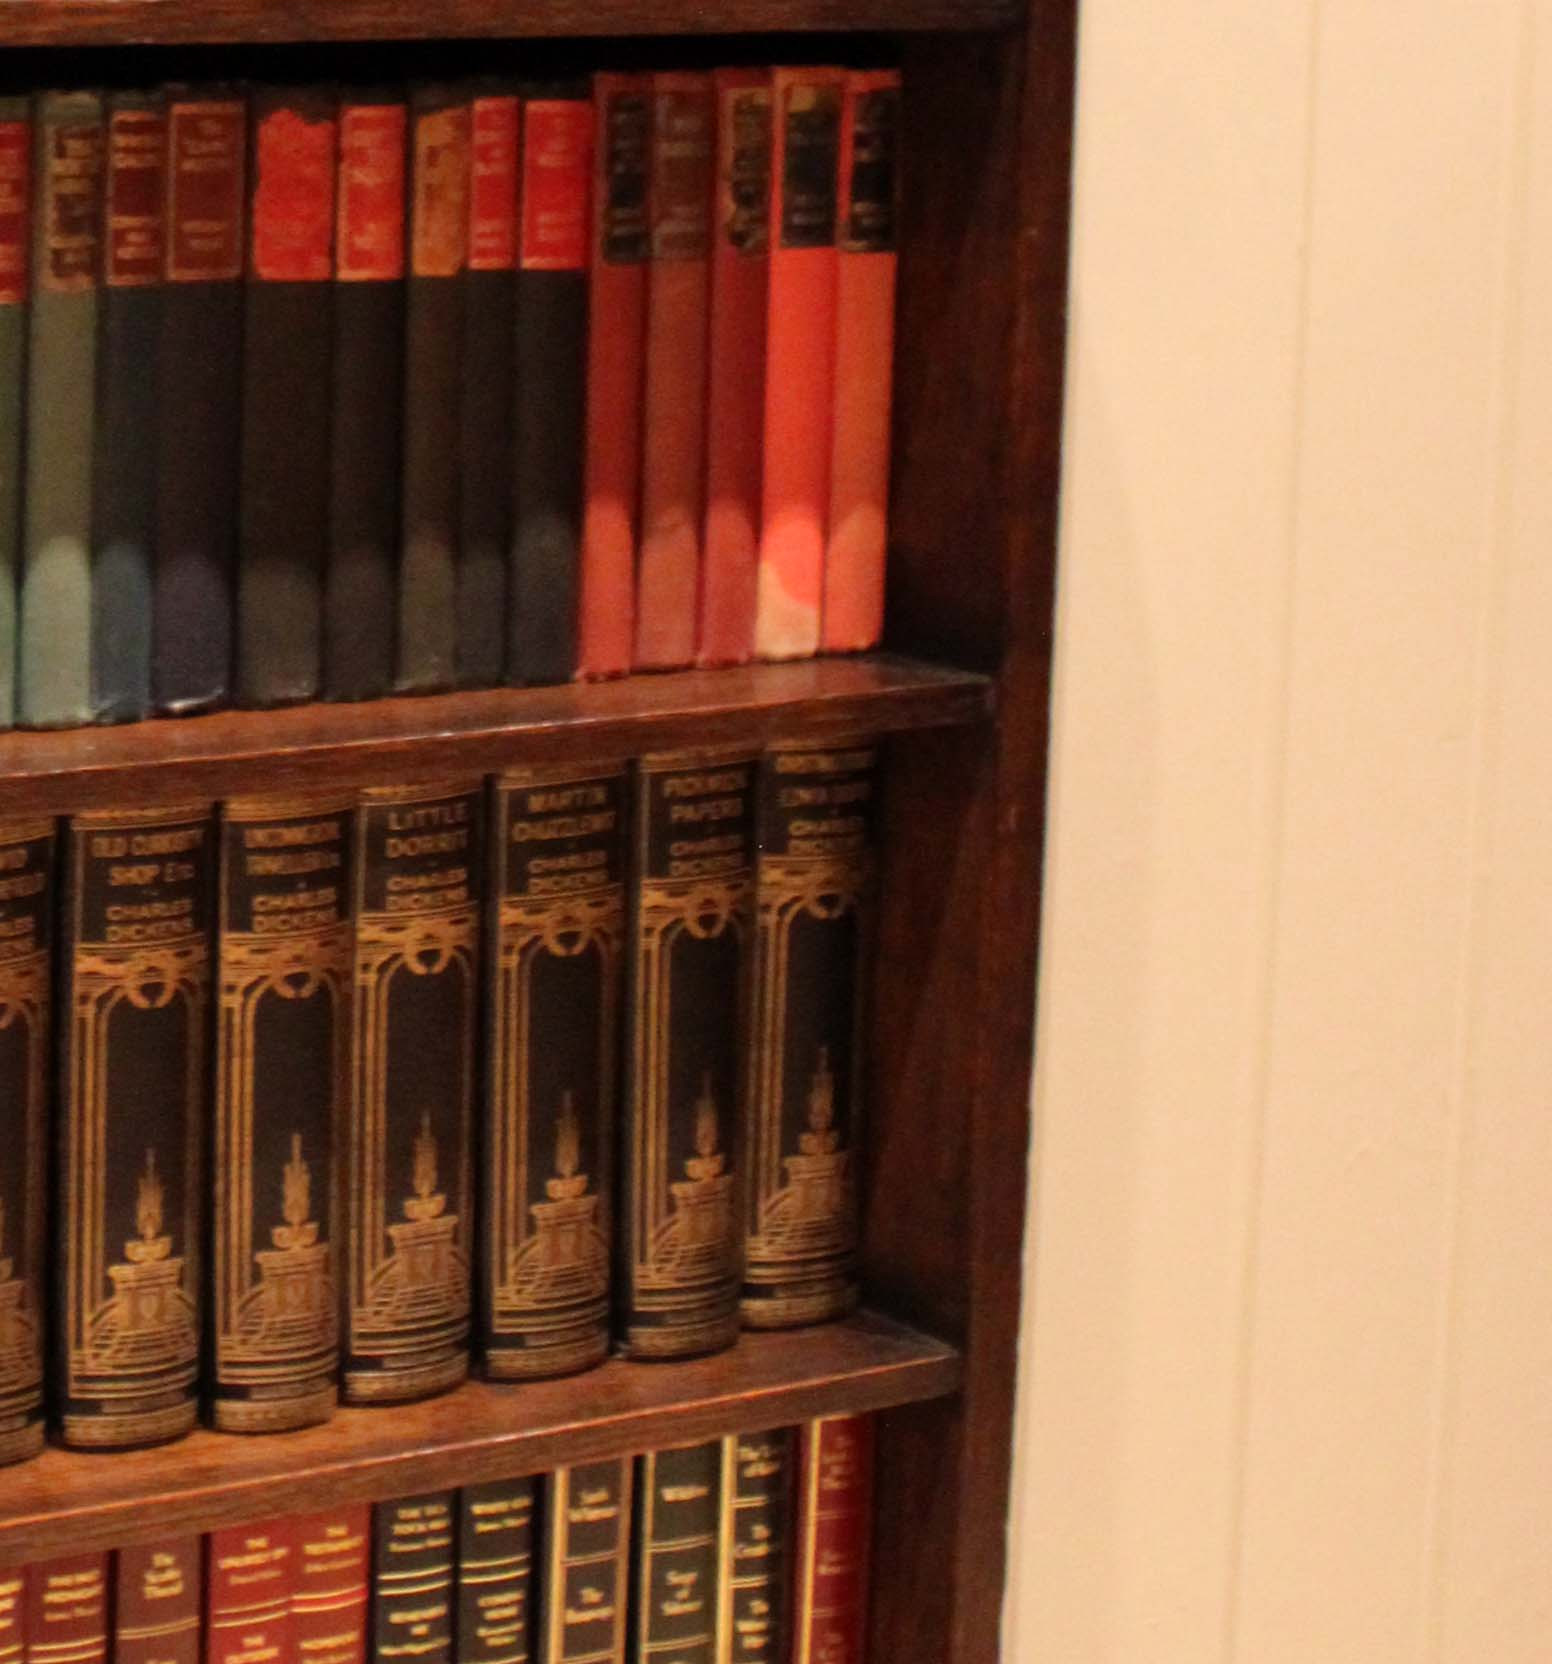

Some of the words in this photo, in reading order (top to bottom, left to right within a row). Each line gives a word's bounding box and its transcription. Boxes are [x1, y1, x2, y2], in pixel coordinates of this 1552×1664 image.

[529, 788, 606, 813] MARTIN
[388, 802, 467, 830] LITTLE
[513, 811, 616, 842] CHUZZLEWIT
[92, 837, 127, 858] OLD
[130, 830, 203, 855] CURIOSITY
[386, 830, 468, 858] DORRIT
[670, 835, 744, 857] CHARLES
[529, 851, 607, 874] CHARLES
[670, 853, 744, 876] DICKENS
[109, 864, 159, 886] SHOP
[387, 868, 467, 891] CHARLES
[529, 870, 608, 895] DICKENS
[107, 899, 194, 922] CHARLES
[253, 887, 337, 912] CHARLES
[386, 887, 468, 911] DICKENS
[107, 918, 194, 942] DICKENS
[253, 908, 337, 933] DICKENS
